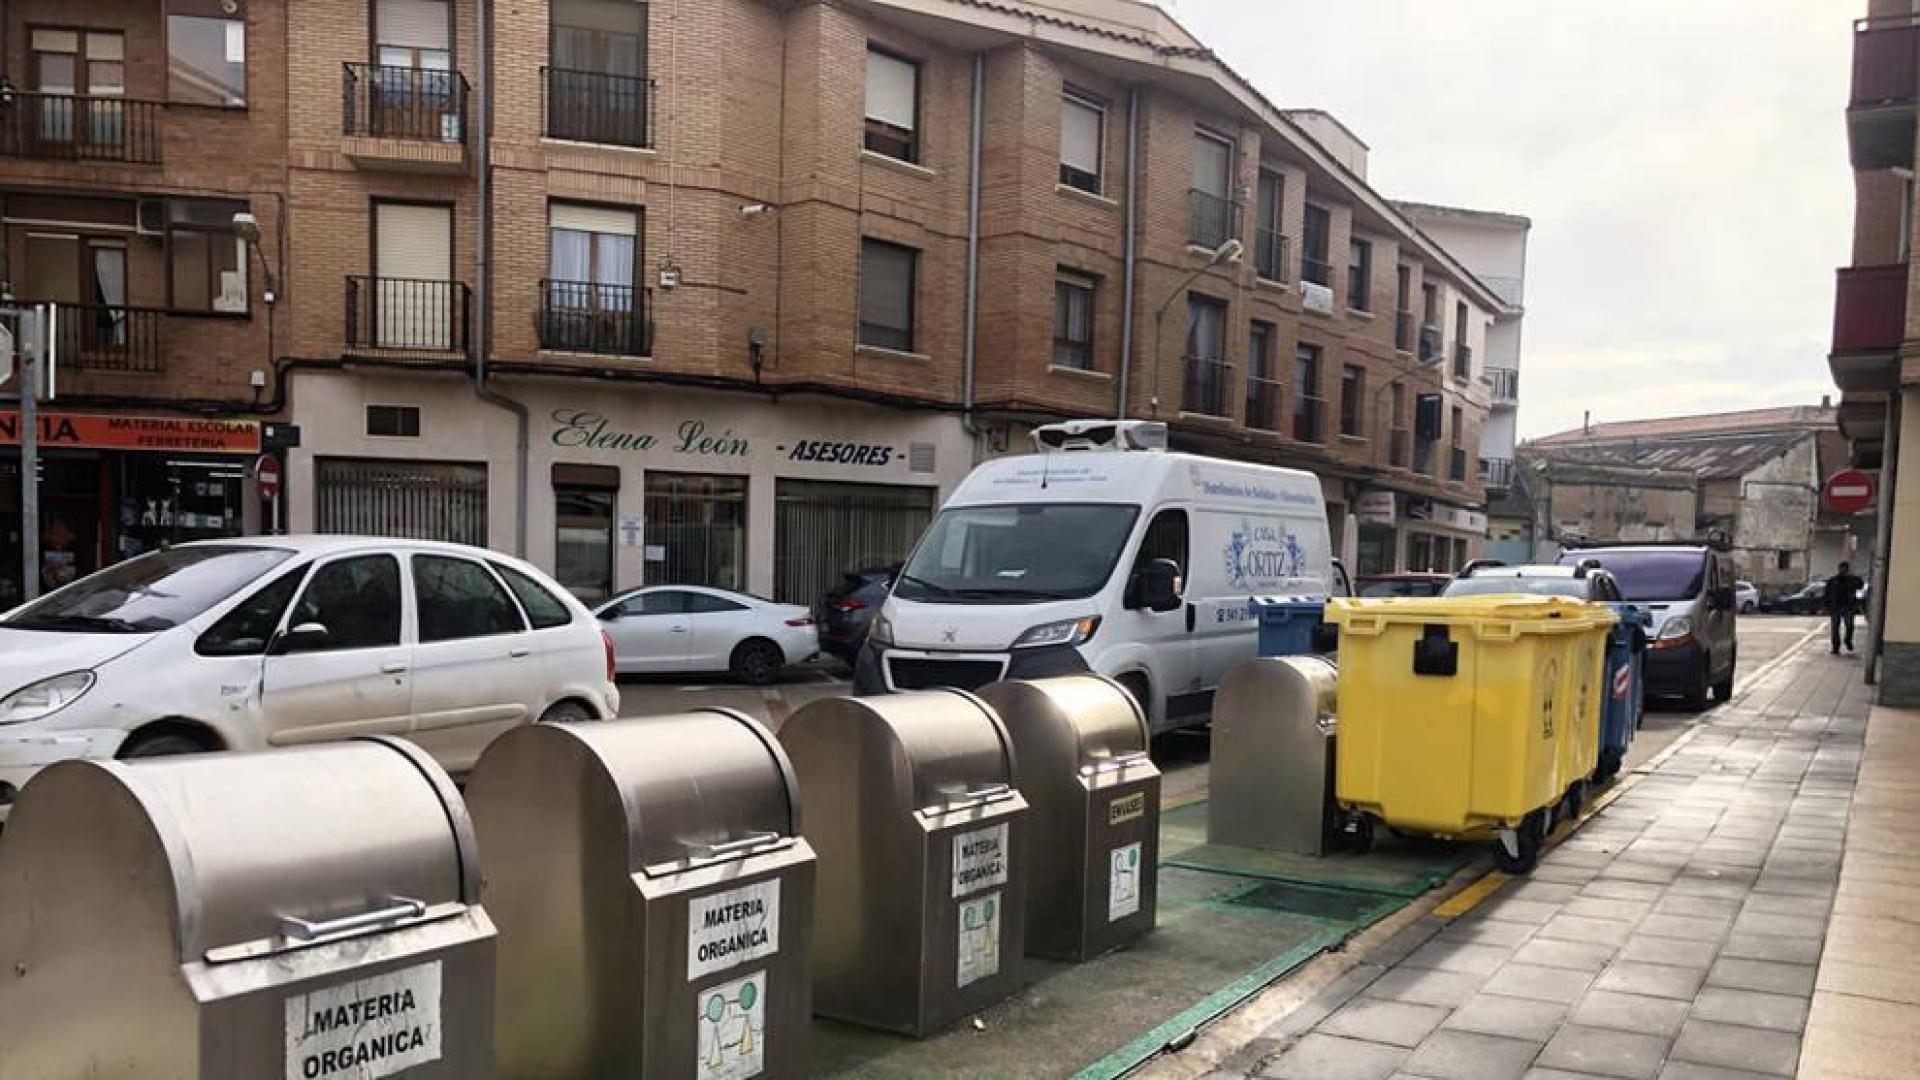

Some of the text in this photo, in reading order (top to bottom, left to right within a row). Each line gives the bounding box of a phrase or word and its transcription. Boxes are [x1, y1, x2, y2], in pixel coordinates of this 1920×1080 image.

[0, 413, 80, 442] NIA
[109, 418, 254, 434] MATERIAL ESCOLAR
[551, 408, 748, 456] Elena León
[788, 440, 893, 465] ASESORES
[1247, 550, 1285, 576] ORTIZ
[961, 838, 1000, 858] MATERIA
[959, 860, 1001, 884] ORGANICA
[704, 899, 763, 928] MATERIA
[698, 928, 767, 962] ORGANICA
[313, 988, 416, 1034] MATERIA
[303, 1026, 424, 1079] ORGANICA
